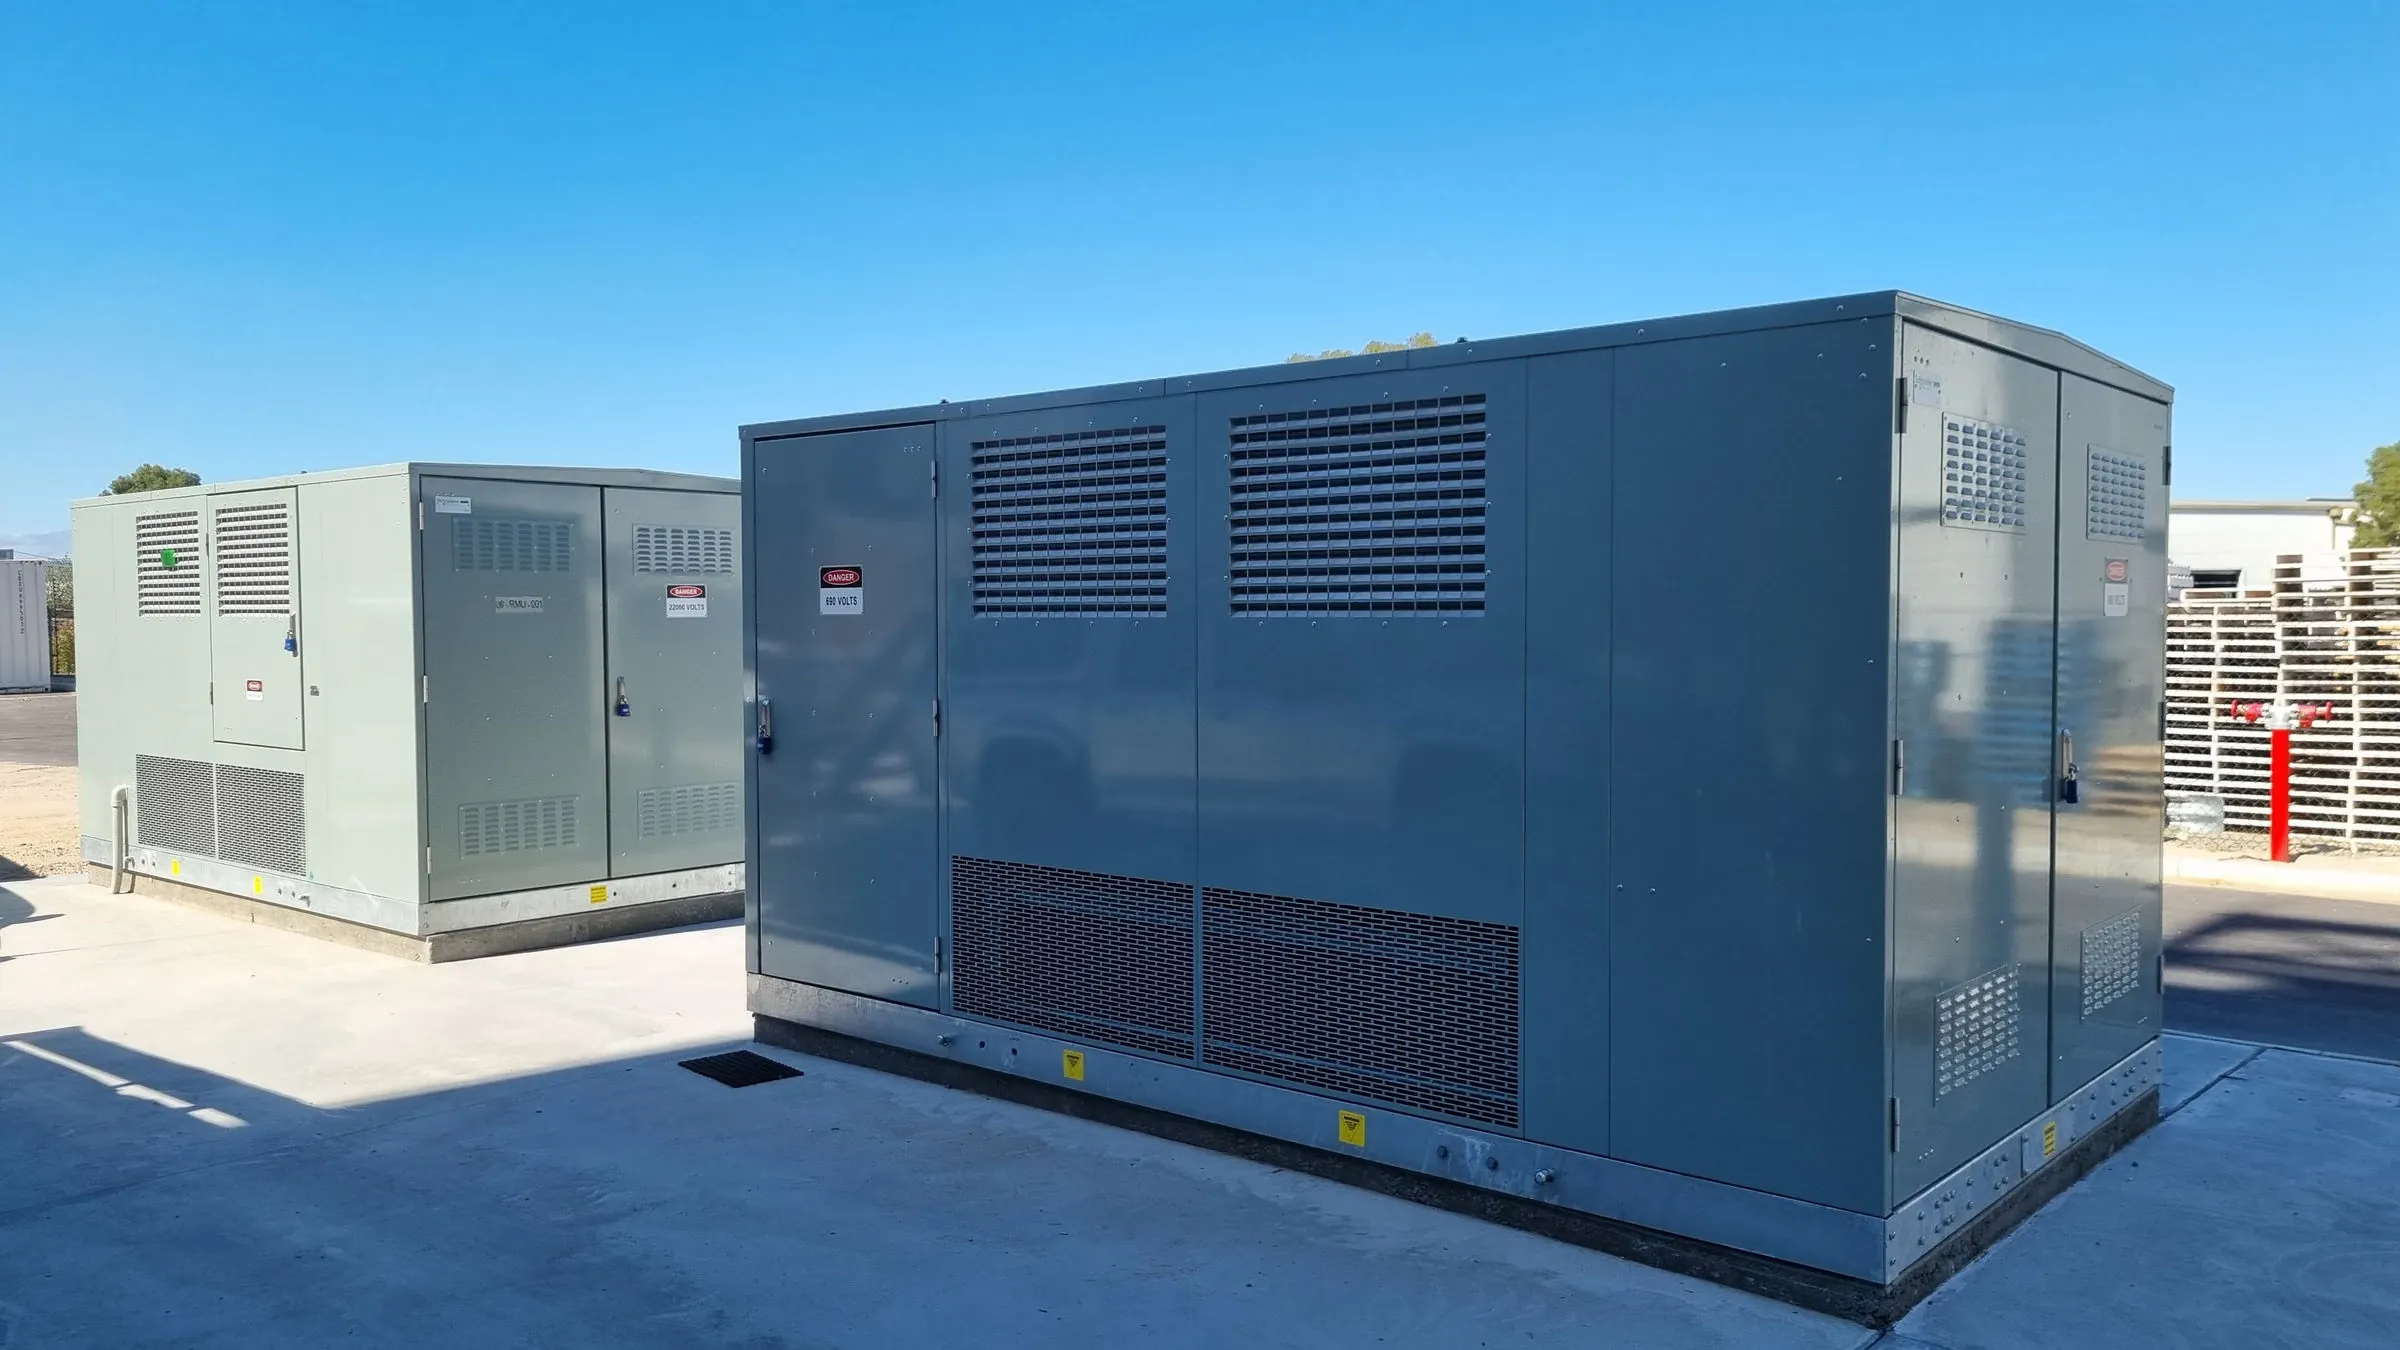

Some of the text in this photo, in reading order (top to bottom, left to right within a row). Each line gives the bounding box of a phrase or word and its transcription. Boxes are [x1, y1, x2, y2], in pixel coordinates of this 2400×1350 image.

[828, 573, 855, 582] DANGER
[826, 596, 858, 606] 690 VOLTS
[686, 603, 705, 611] VOLTS
